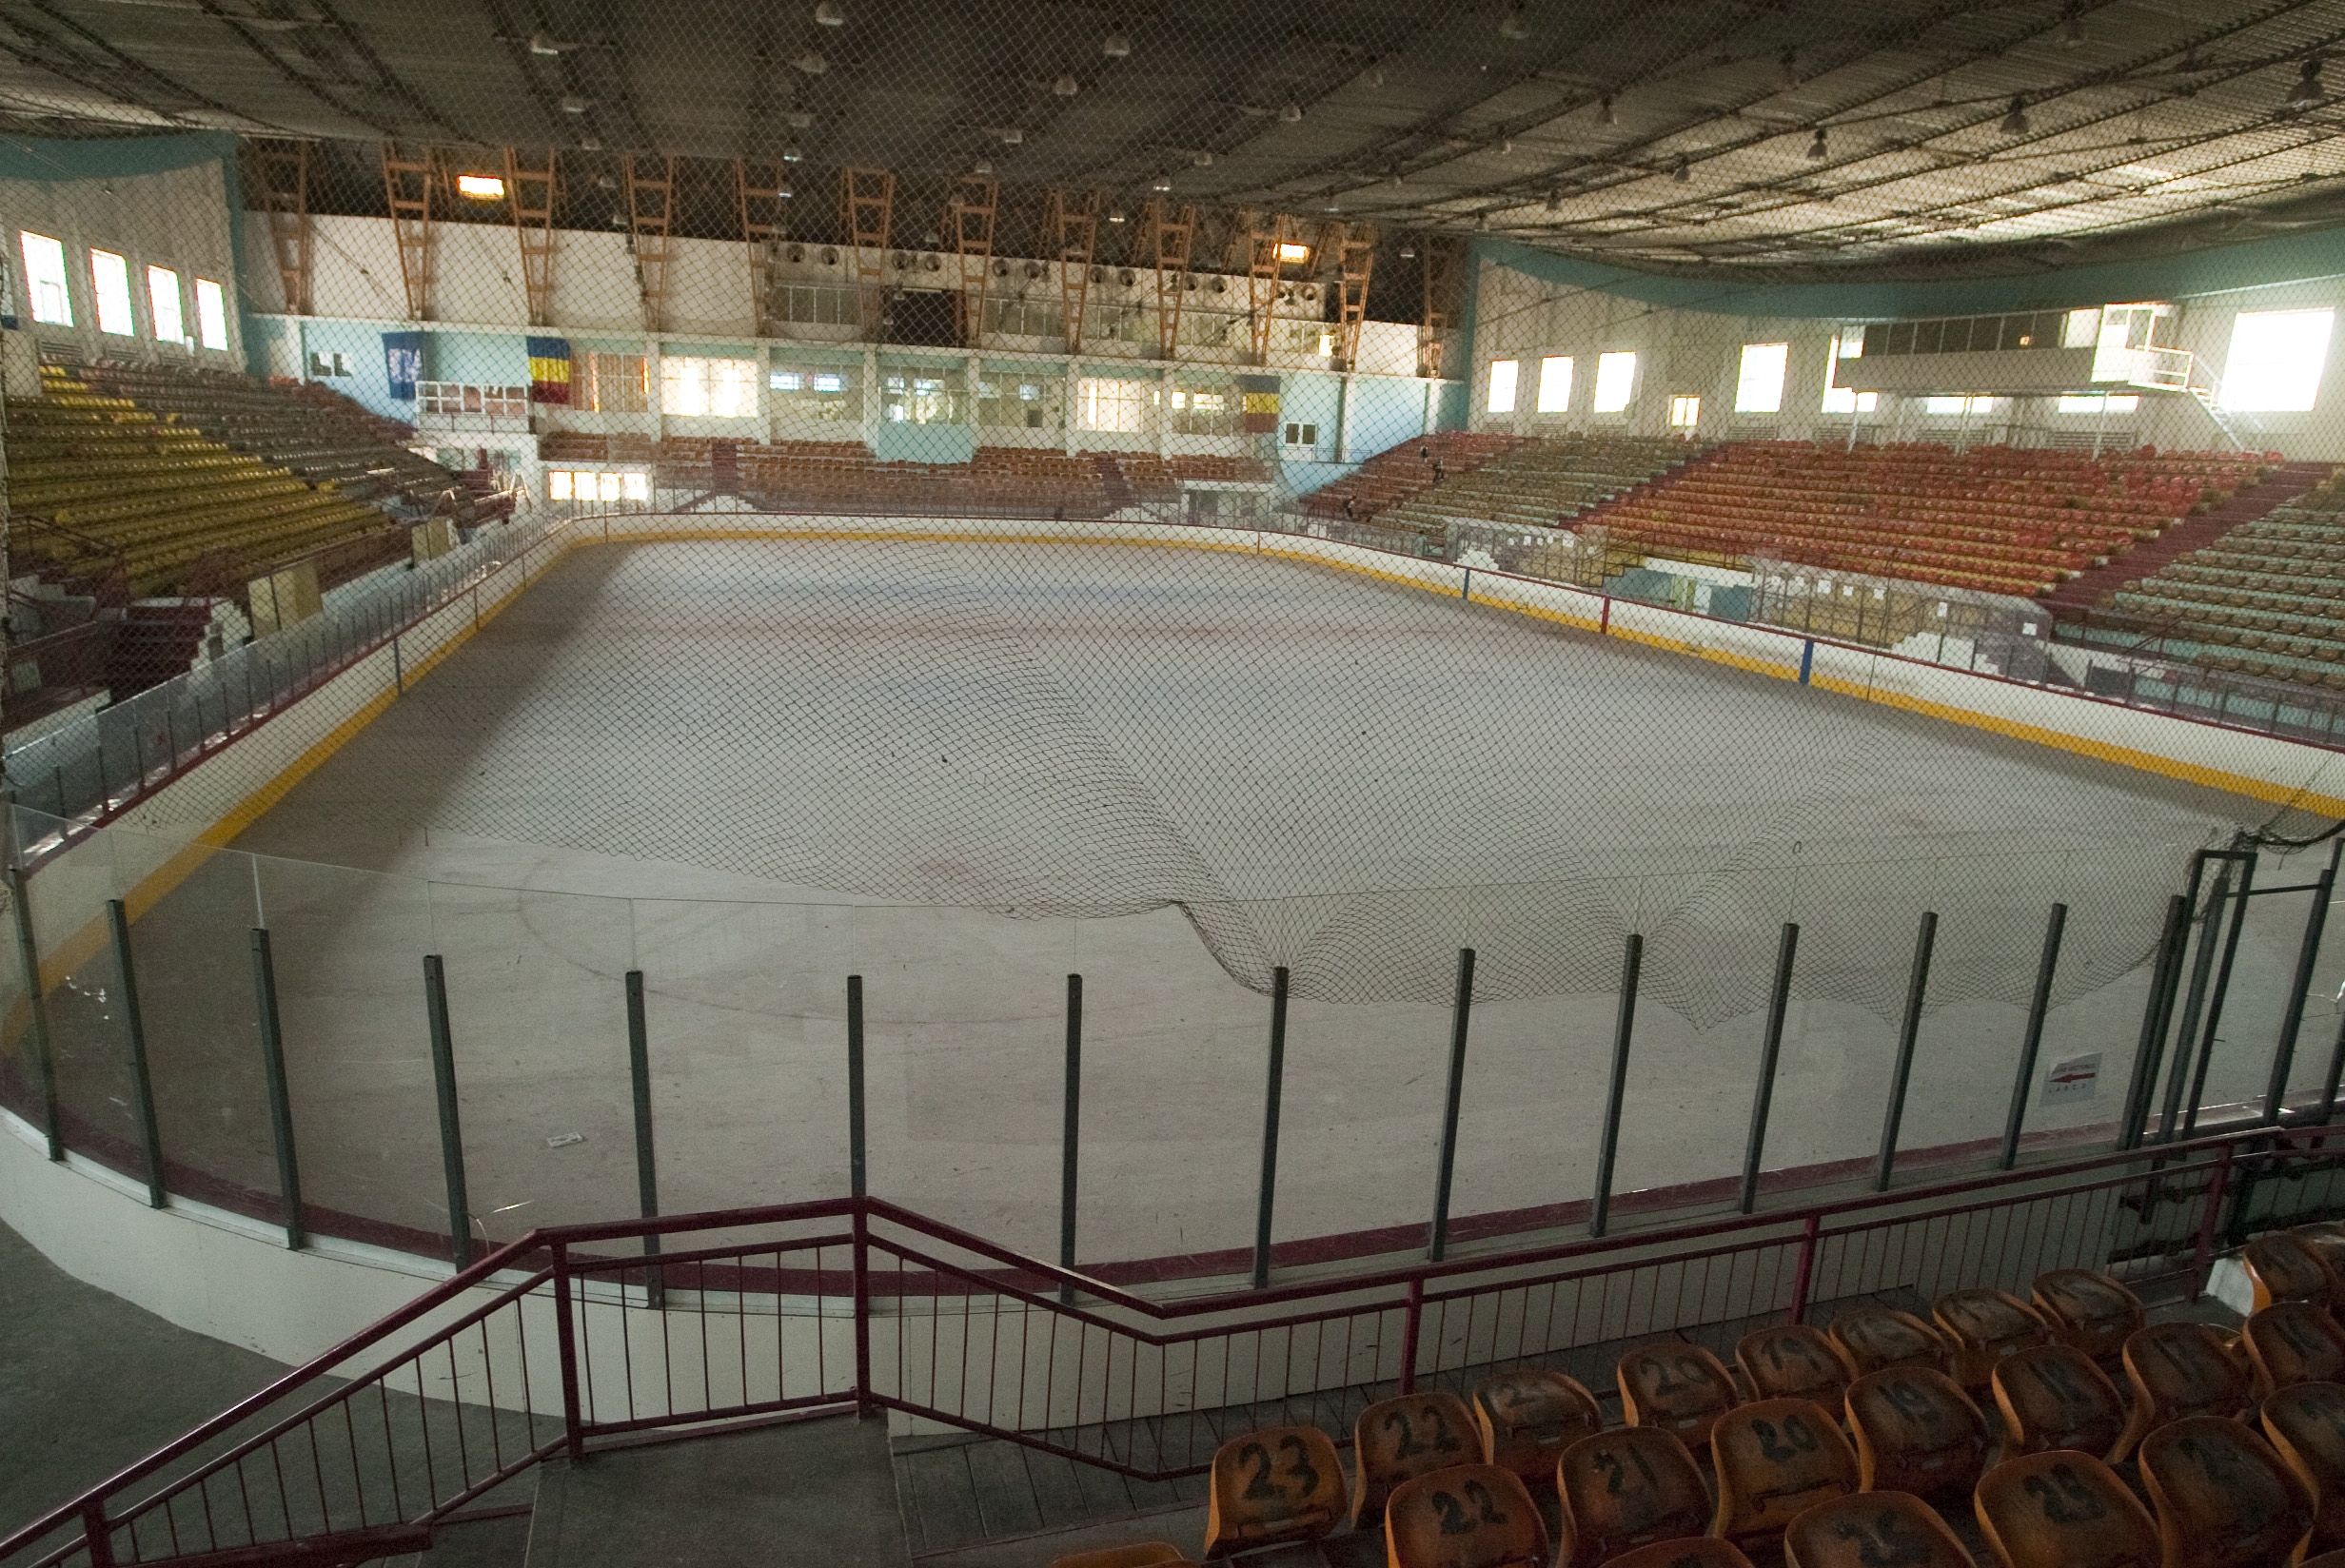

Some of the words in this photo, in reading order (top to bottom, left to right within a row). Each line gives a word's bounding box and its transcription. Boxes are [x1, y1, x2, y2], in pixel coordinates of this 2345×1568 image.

[1640, 1356, 1715, 1397] 20
[1384, 1404, 1462, 1460] 22
[1751, 1414, 1818, 1462] 20
[1239, 1434, 1320, 1499] 23
[1431, 1480, 1508, 1535] 22
